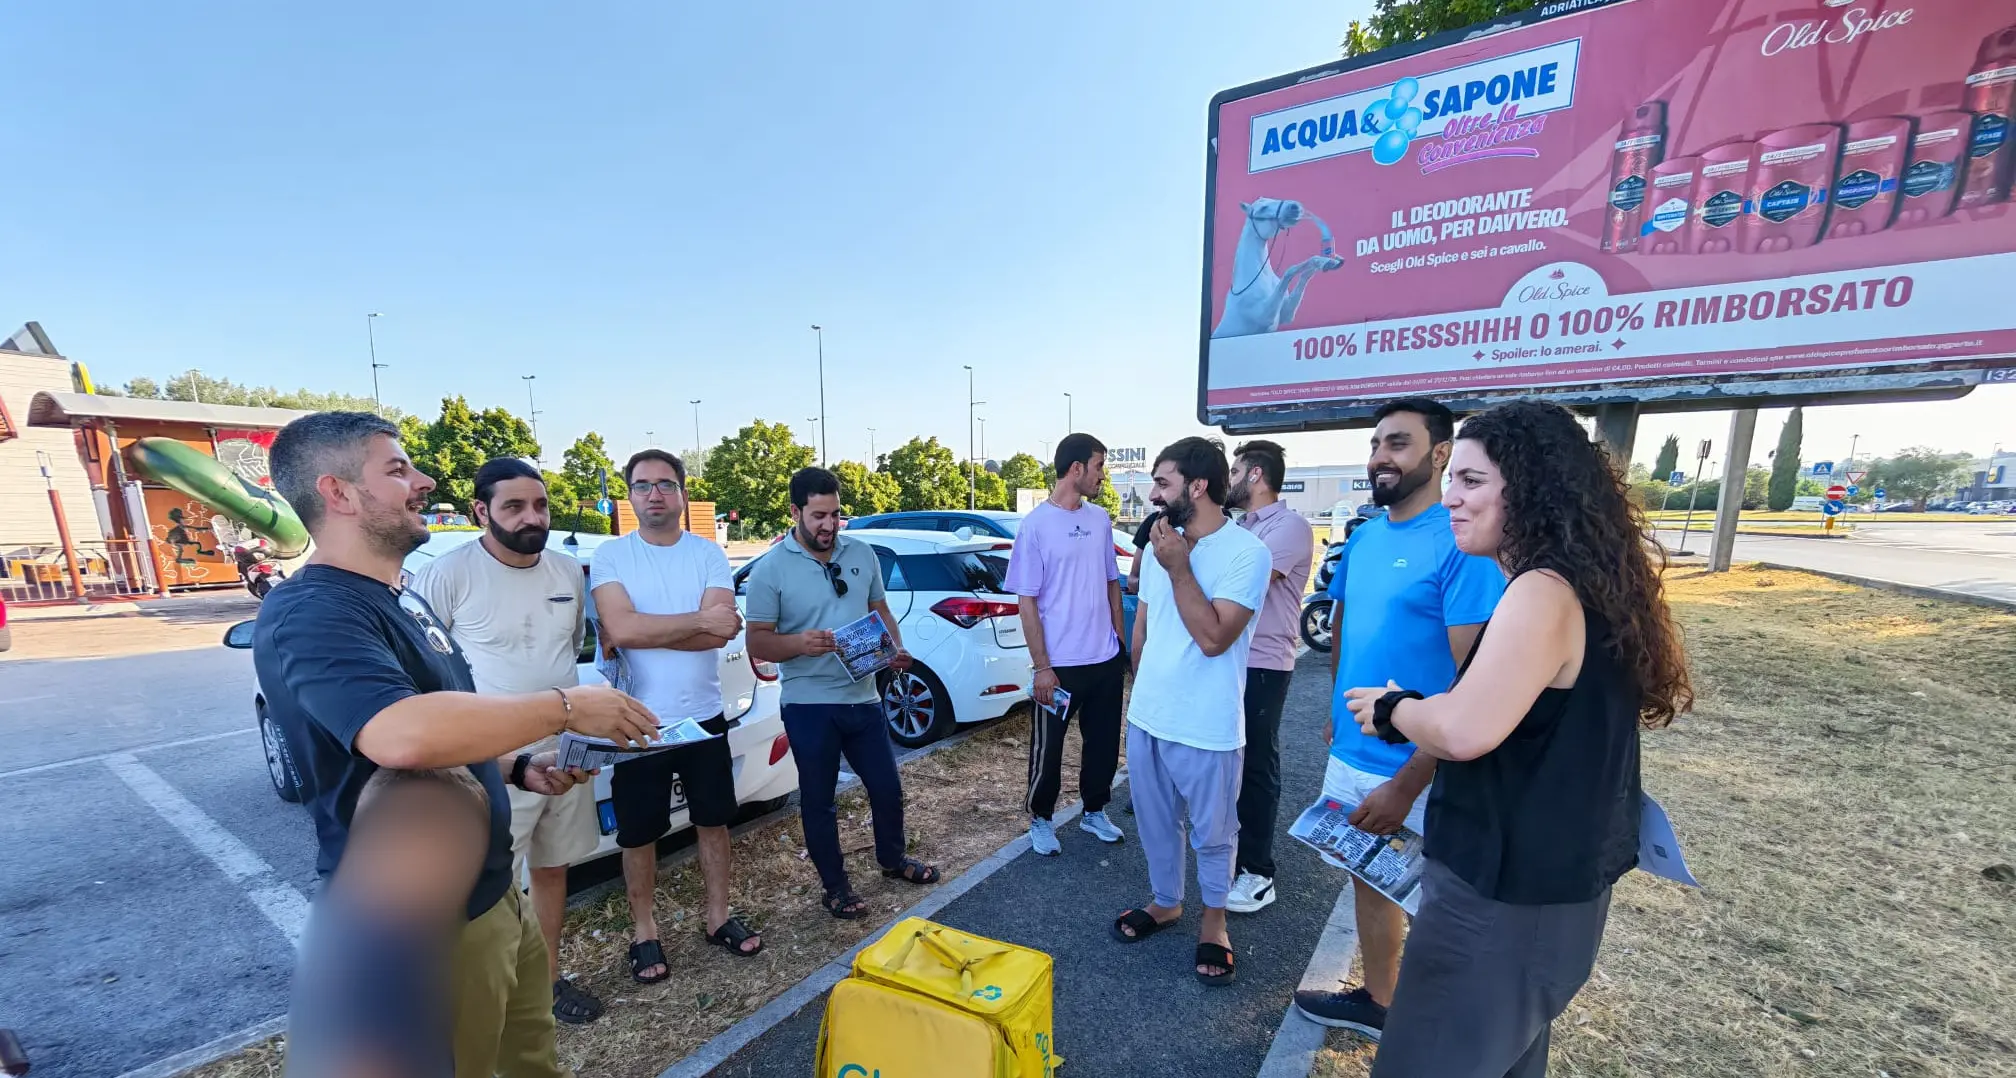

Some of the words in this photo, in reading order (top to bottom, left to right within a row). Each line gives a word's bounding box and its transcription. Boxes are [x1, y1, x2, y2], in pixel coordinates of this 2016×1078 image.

[1541, 0, 1609, 17] ADRIATI
[1762, 20, 1828, 57] Old
[1824, 8, 1914, 43] Spice
[1261, 110, 1358, 155] ACQUA
[1422, 61, 1558, 121] SAPONE
[1442, 112, 1493, 140] Oltre
[1496, 102, 1520, 125] la
[1418, 115, 1548, 165] Convenienza
[1391, 211, 1407, 229] IL
[1410, 188, 1533, 226] DEODORANTE
[1356, 237, 1380, 257] DA
[1383, 225, 1438, 251] UOMO,
[1440, 218, 1475, 241] PER
[1478, 207, 1569, 235] DAVVERO.
[1370, 261, 1404, 275] Scegli
[1405, 256, 1425, 270] Old
[1426, 252, 1459, 268] Spice
[1460, 252, 1468, 261] e
[1470, 247, 1488, 260] sei
[1489, 246, 1498, 256] a
[1499, 239, 1547, 256] cavallo.
[1519, 285, 1550, 303] Old
[1549, 282, 1591, 300] Spice
[1292, 332, 1358, 361] 100%
[1365, 315, 1522, 354] FRESSSHHH
[1558, 302, 1645, 337] 100%
[1654, 275, 1914, 329] RIMBORSATO
[1491, 347, 1538, 362] Spoiler:
[1552, 340, 1603, 355] amerai.
[1105, 447, 1146, 462] SSINI
